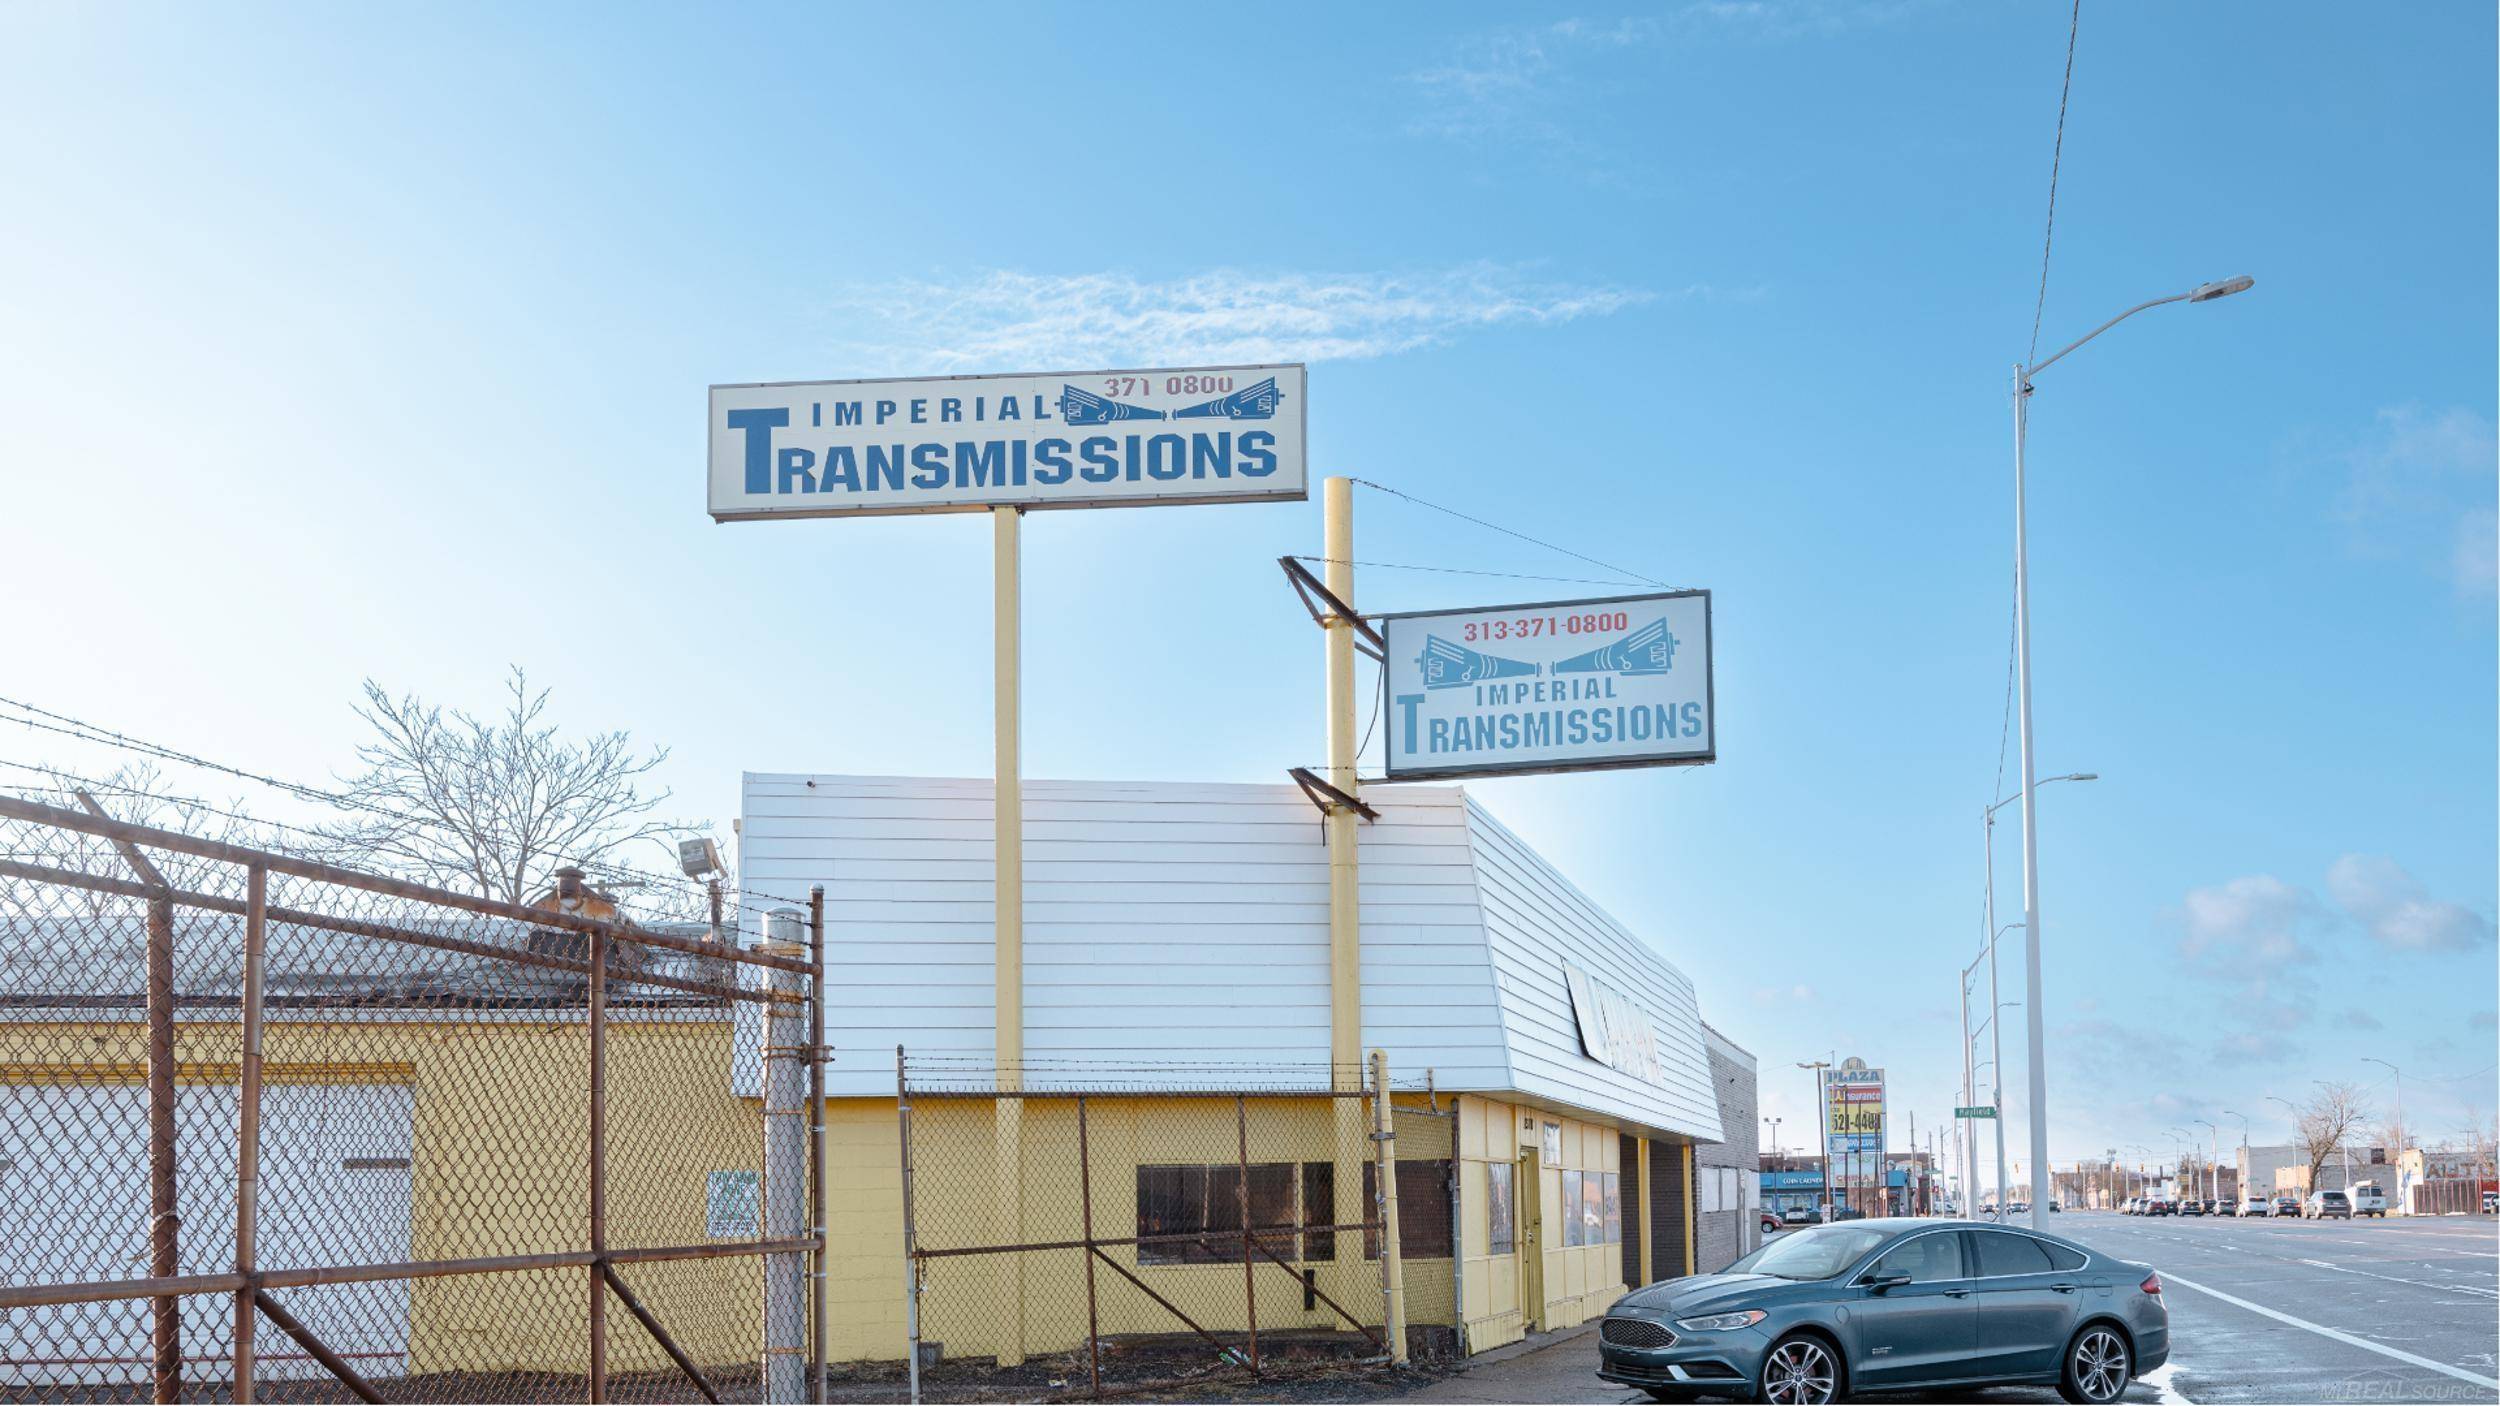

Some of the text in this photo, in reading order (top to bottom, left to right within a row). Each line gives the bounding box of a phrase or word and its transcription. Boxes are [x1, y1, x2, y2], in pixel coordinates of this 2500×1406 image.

[1105, 375, 1234, 398] 371 0800
[812, 395, 1052, 427] IMPERIAL
[728, 407, 1277, 495] TRANSMISSIONS
[1464, 612, 1628, 642] 313-371-0800
[1476, 676, 1617, 706] IMPERIAL
[1397, 693, 1702, 755] TRANSMISSIONS
[1827, 1070, 1880, 1082] PLAZA
